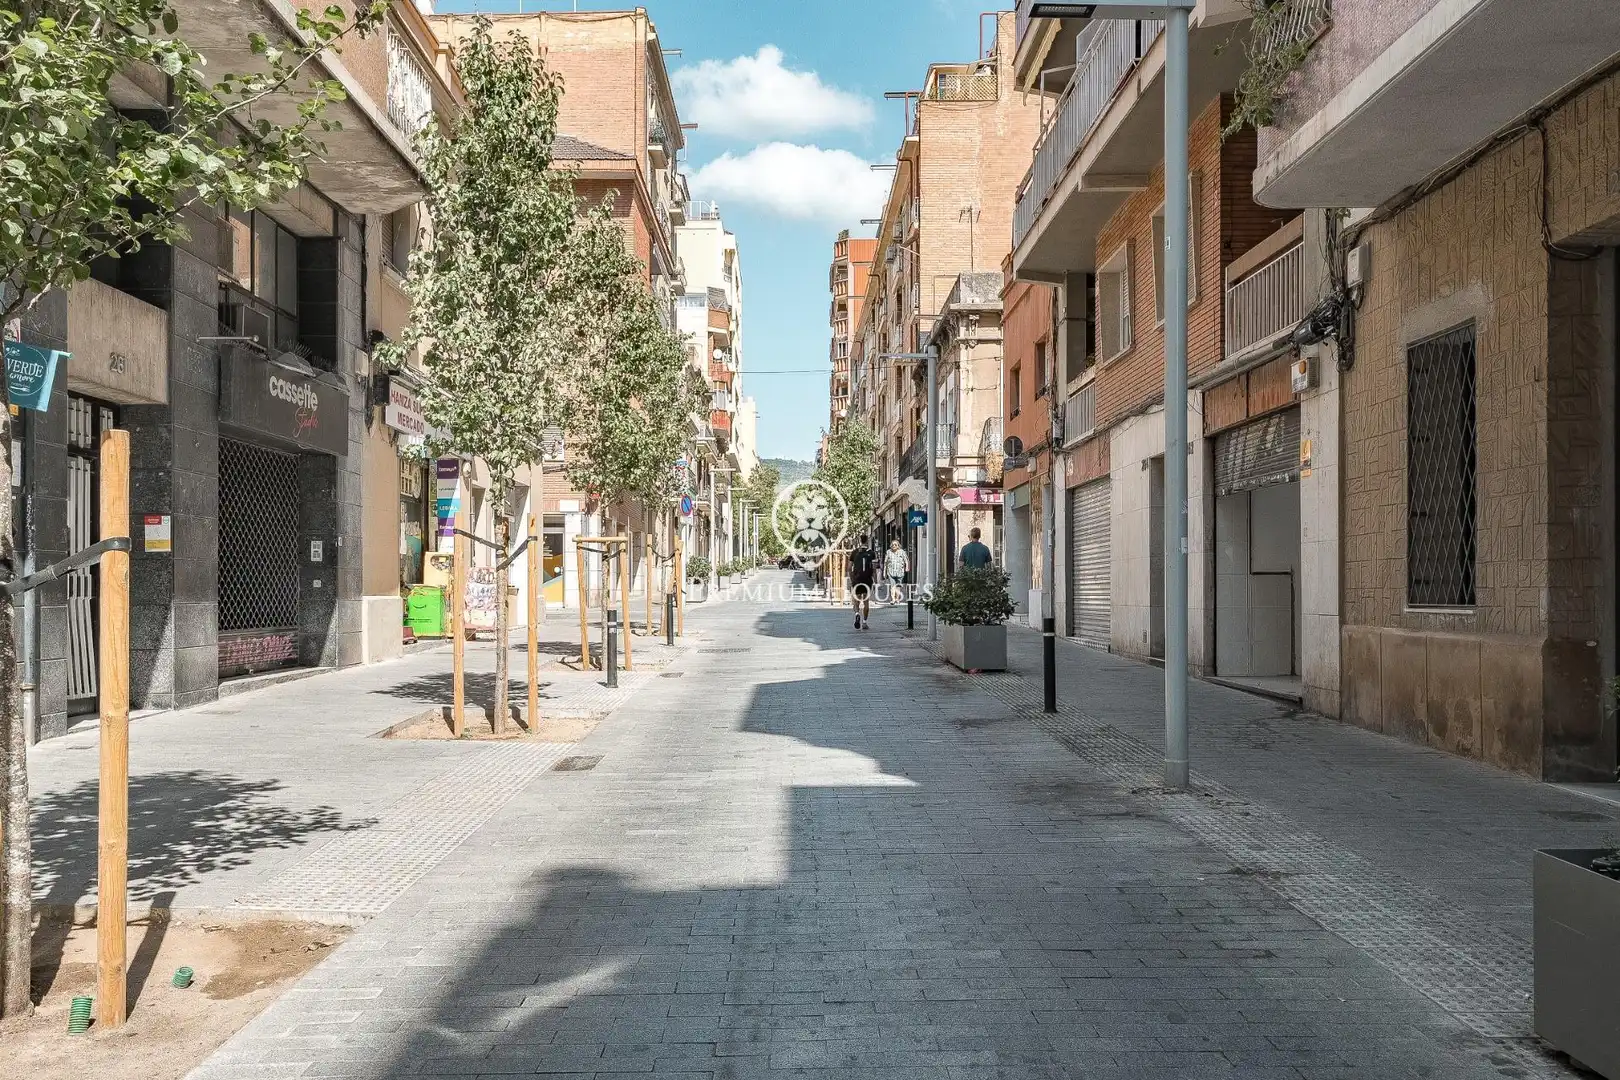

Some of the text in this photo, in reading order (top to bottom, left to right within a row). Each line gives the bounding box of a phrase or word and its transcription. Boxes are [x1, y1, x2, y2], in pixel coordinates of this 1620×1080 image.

[7, 357, 44, 378] VERDE
[9, 372, 35, 383] amore
[269, 375, 318, 412] cassette
[397, 411, 425, 435] MERCADO
